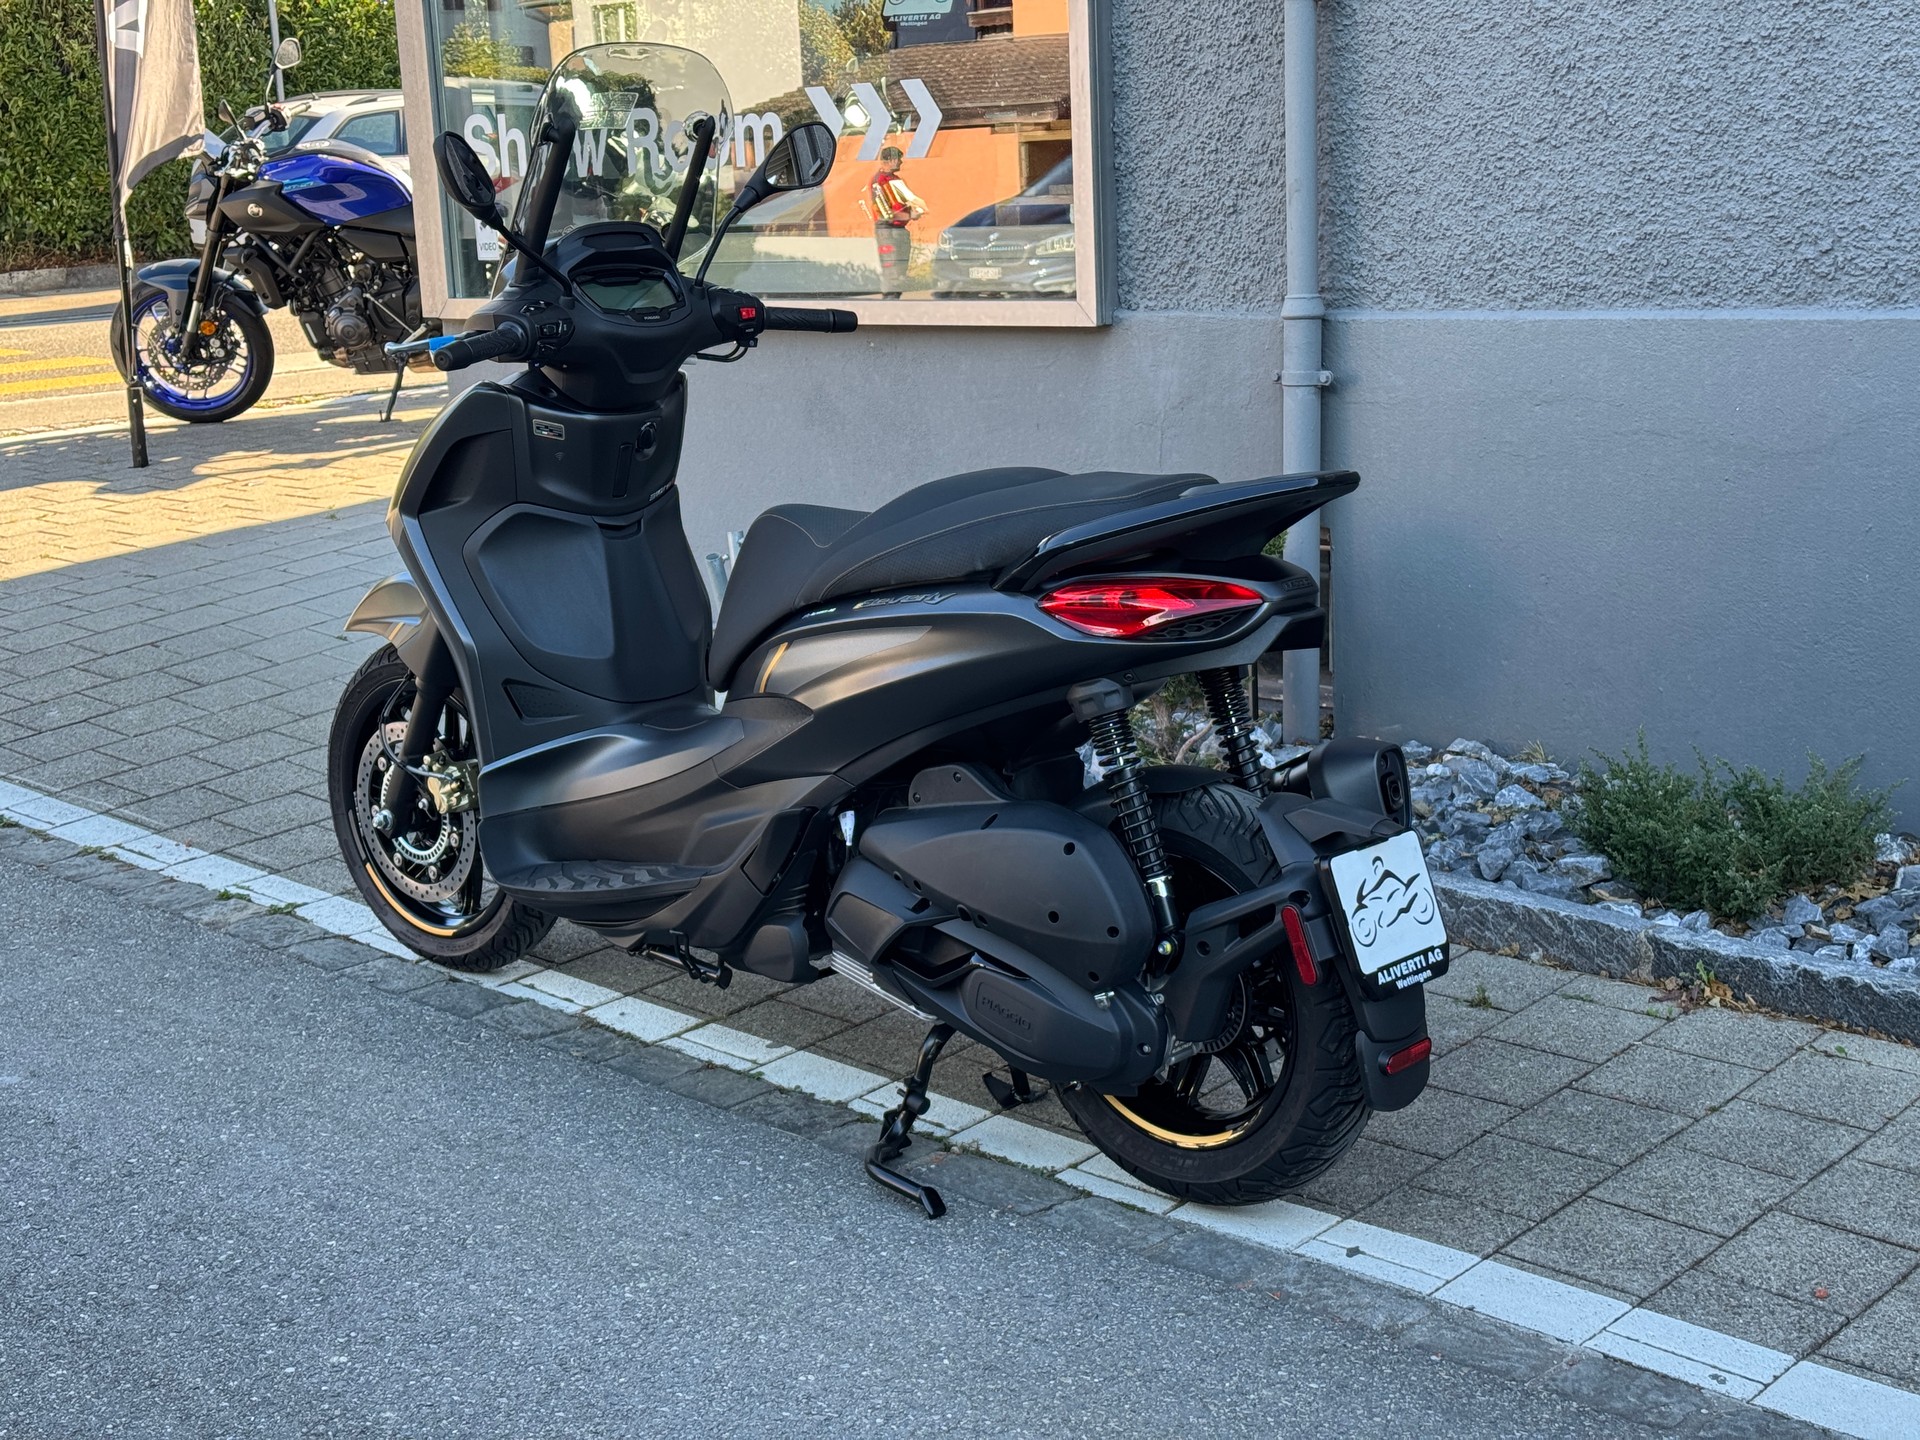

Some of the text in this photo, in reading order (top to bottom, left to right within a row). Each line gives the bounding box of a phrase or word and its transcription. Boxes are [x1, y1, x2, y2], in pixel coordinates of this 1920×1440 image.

[889, 14, 927, 22] ALIVERTI
[464, 113, 608, 178] Shw
[479, 242, 497, 251] VIDEO
[1377, 948, 1443, 985] ALIVERTI AG
[1395, 969, 1432, 990] Wettingen
[981, 997, 1031, 1030] PIAGGIO
